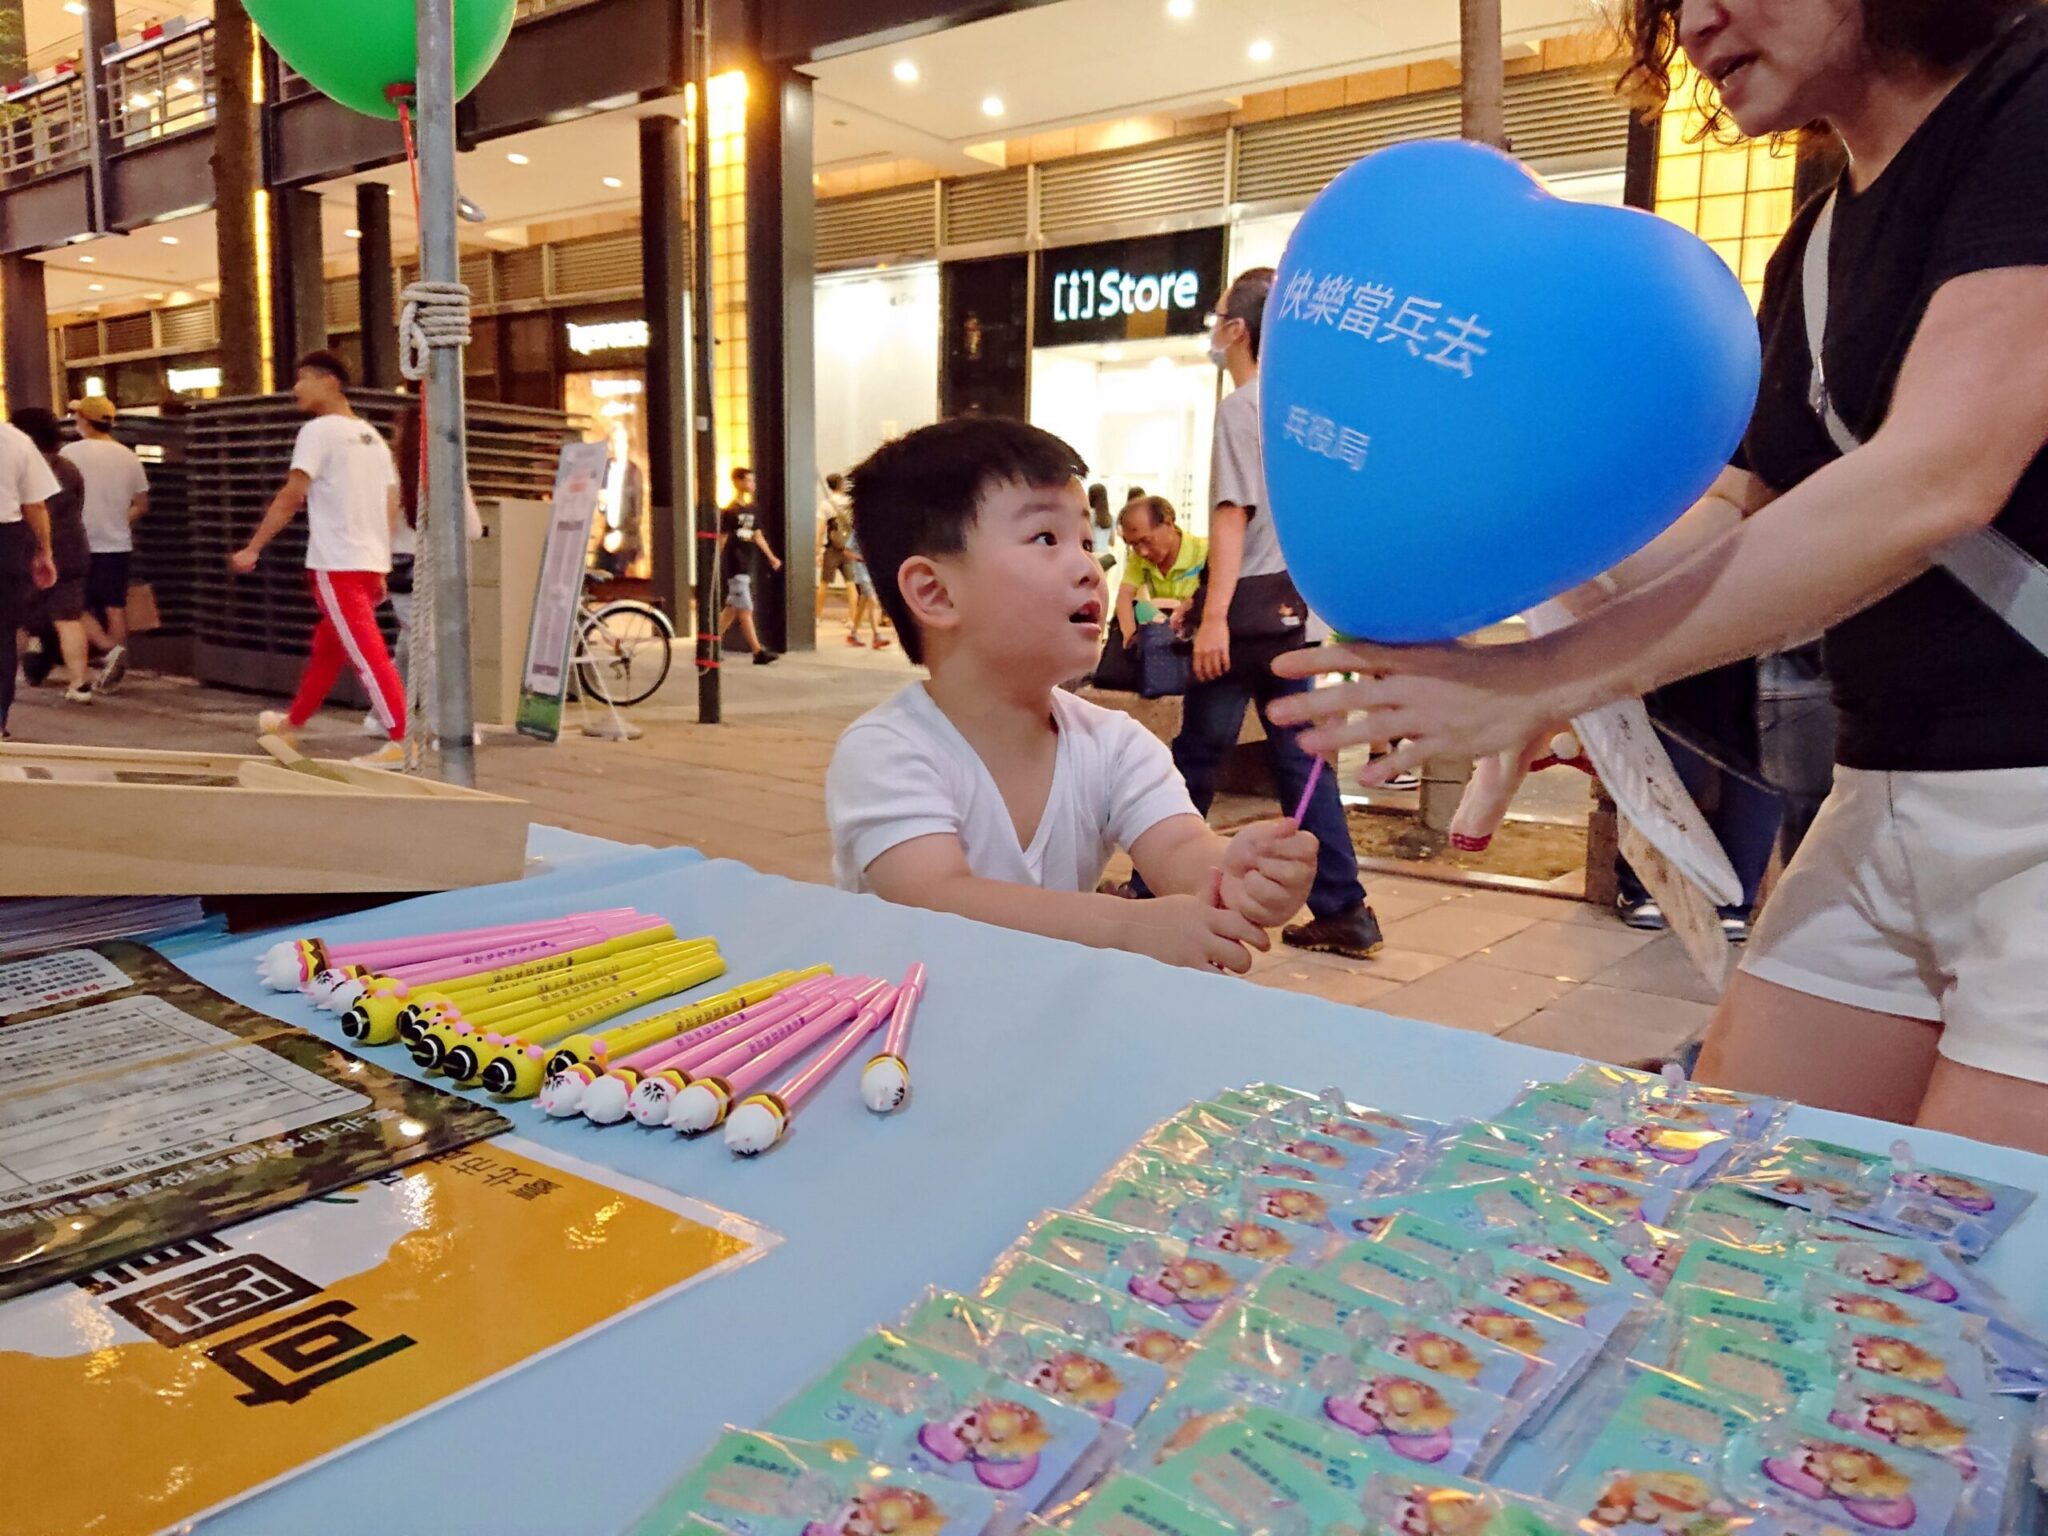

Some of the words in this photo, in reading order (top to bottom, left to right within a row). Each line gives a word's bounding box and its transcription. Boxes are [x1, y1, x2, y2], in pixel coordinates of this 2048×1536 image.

[1053, 267, 1199, 322] [i]Store
[1278, 268, 1492, 379] 快樂當兵去
[1283, 404, 1371, 471] 兵役局
